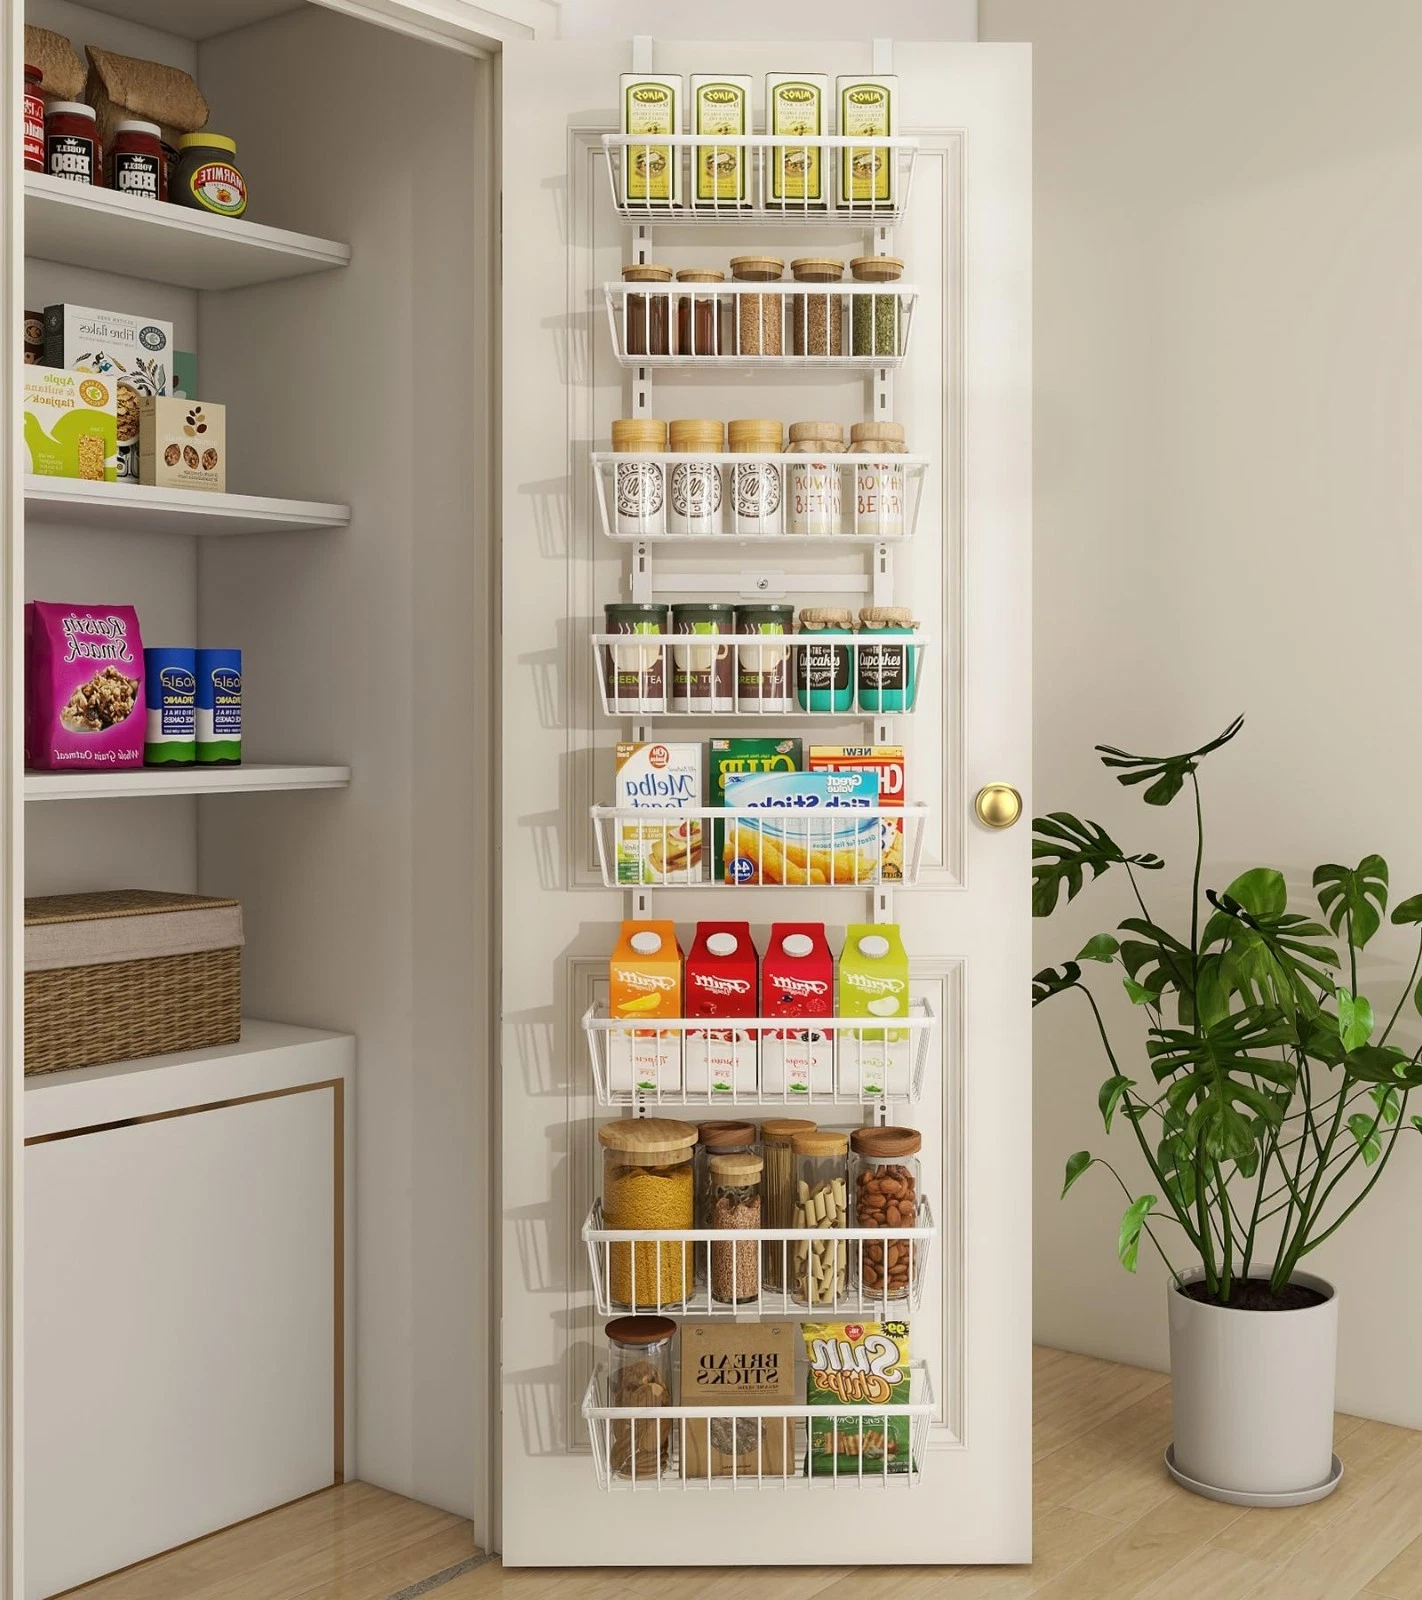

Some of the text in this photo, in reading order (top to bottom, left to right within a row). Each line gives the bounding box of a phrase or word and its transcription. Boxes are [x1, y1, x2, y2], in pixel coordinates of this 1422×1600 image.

[812, 646, 822, 655] THE
[609, 675, 662, 684] GEEN TEA
[674, 675, 698, 684] REEN
